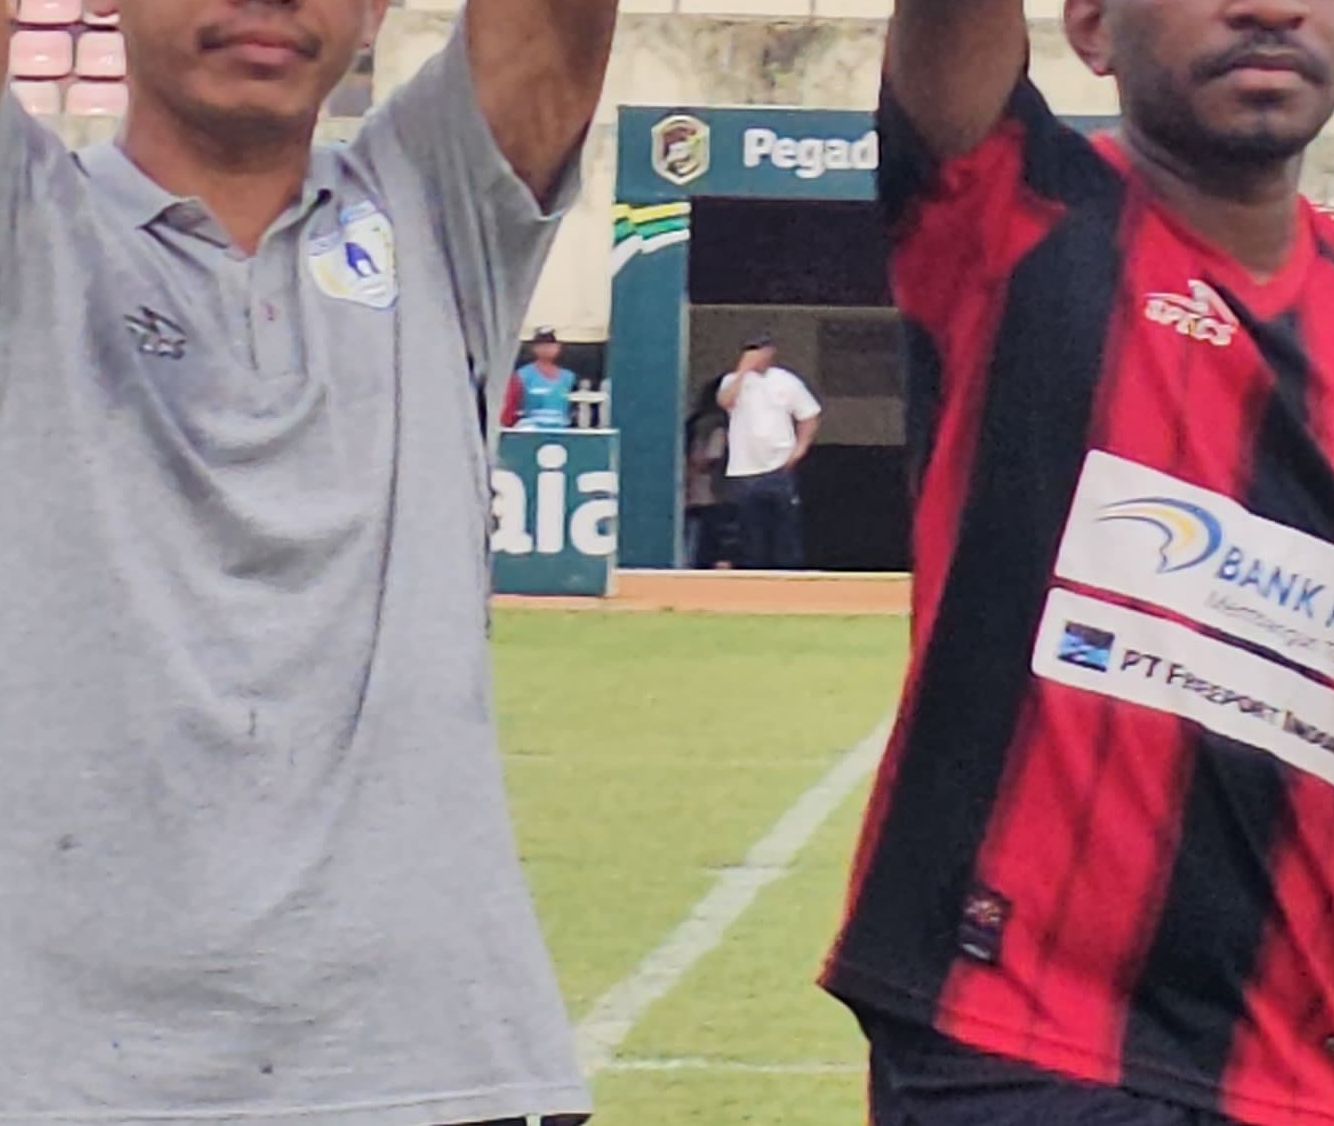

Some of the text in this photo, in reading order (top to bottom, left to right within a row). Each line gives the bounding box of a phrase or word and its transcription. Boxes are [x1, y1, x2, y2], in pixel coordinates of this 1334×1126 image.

[743, 128, 880, 179] Pegad
[1216, 546, 1326, 618] BANK
[1120, 649, 1162, 678] PT
